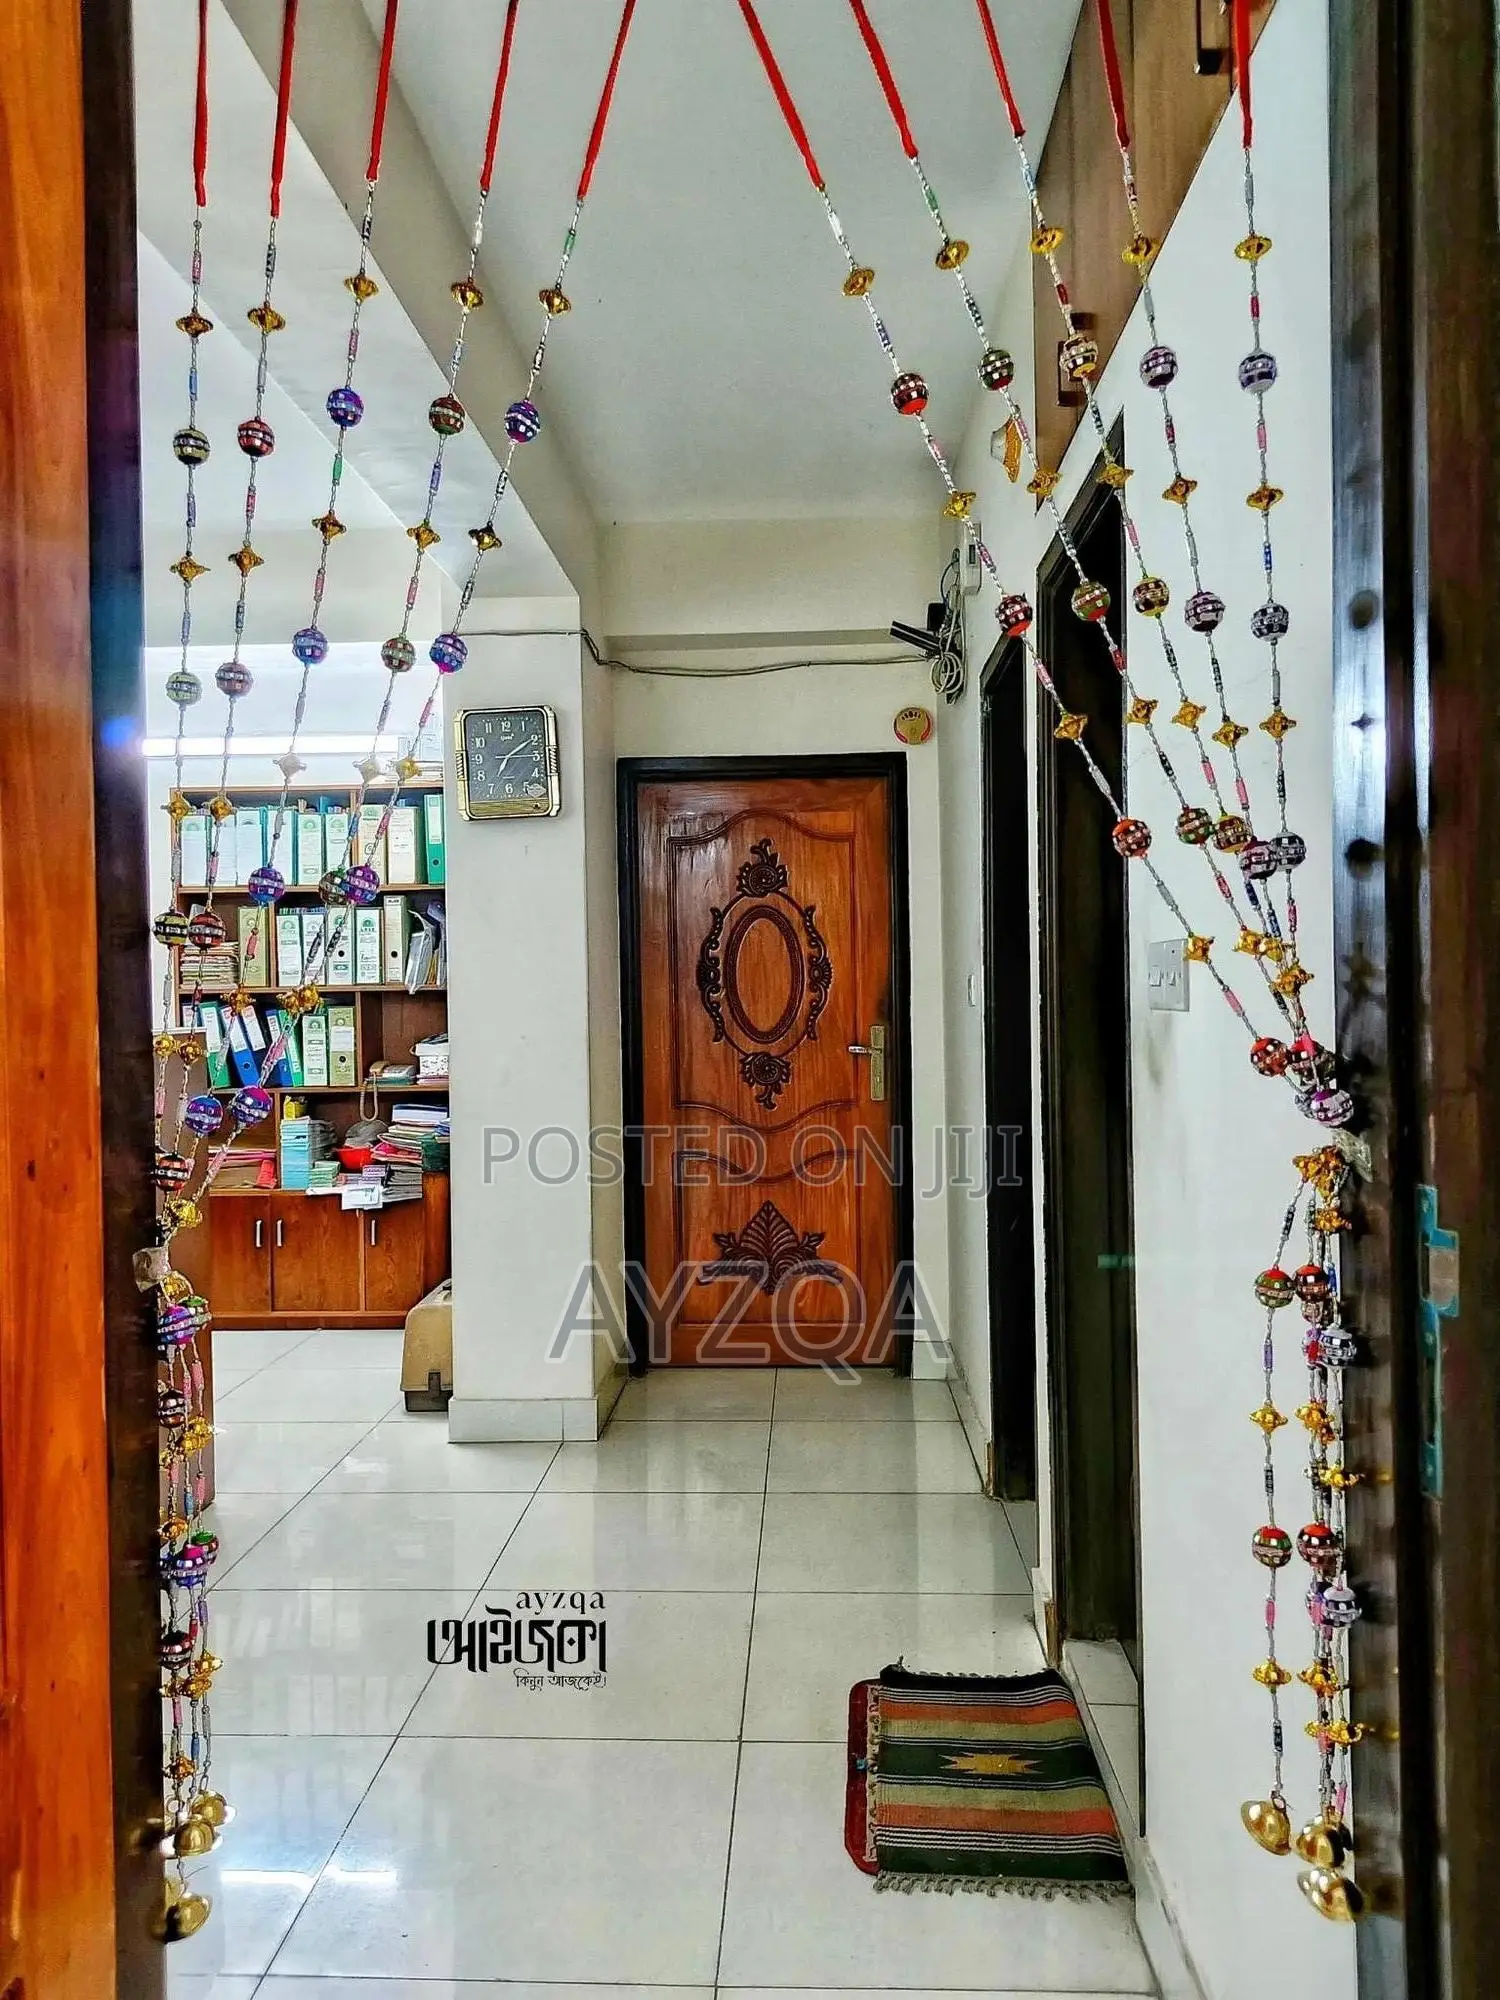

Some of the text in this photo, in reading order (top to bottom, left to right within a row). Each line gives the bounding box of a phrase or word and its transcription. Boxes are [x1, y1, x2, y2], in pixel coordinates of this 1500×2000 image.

[501, 721, 511, 732] 12
[475, 734, 538, 748] 10 2
[475, 753, 483, 765] 9
[478, 767, 540, 782] 8 4
[488, 783, 495, 795] 7
[505, 783, 513, 794] 6
